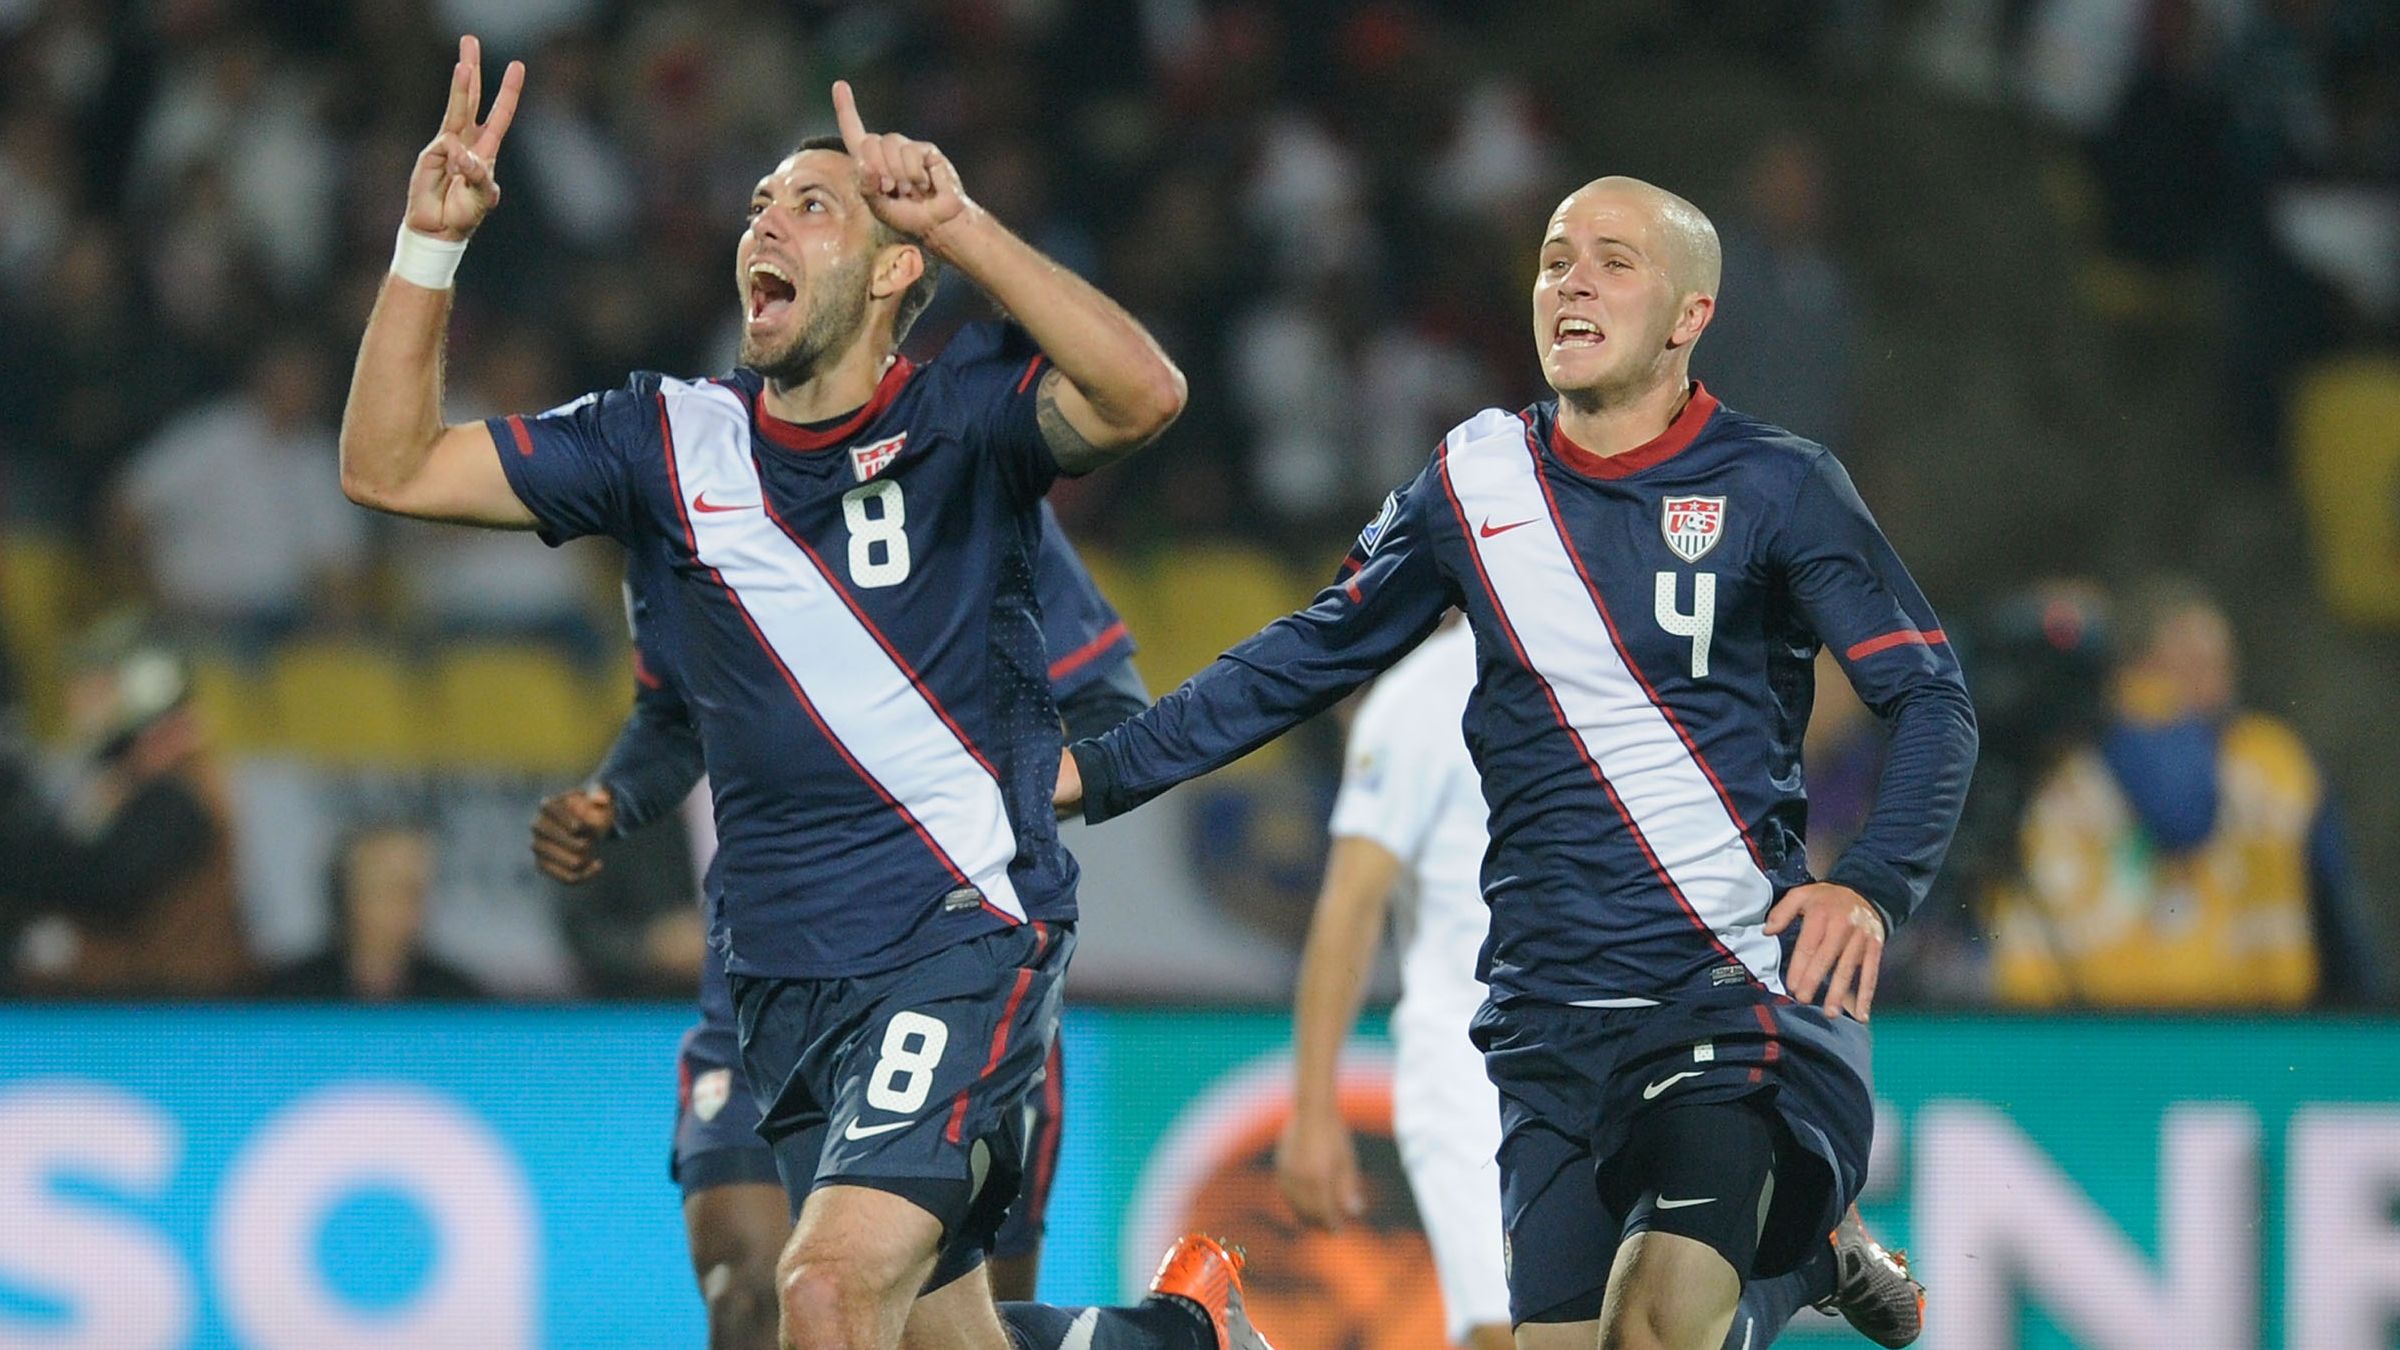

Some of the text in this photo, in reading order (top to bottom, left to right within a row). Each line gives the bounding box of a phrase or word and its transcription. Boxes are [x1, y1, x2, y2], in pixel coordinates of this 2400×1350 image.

[842, 479, 911, 589] 8
[1654, 571, 1717, 679] 4
[866, 1010, 949, 1114] 8
